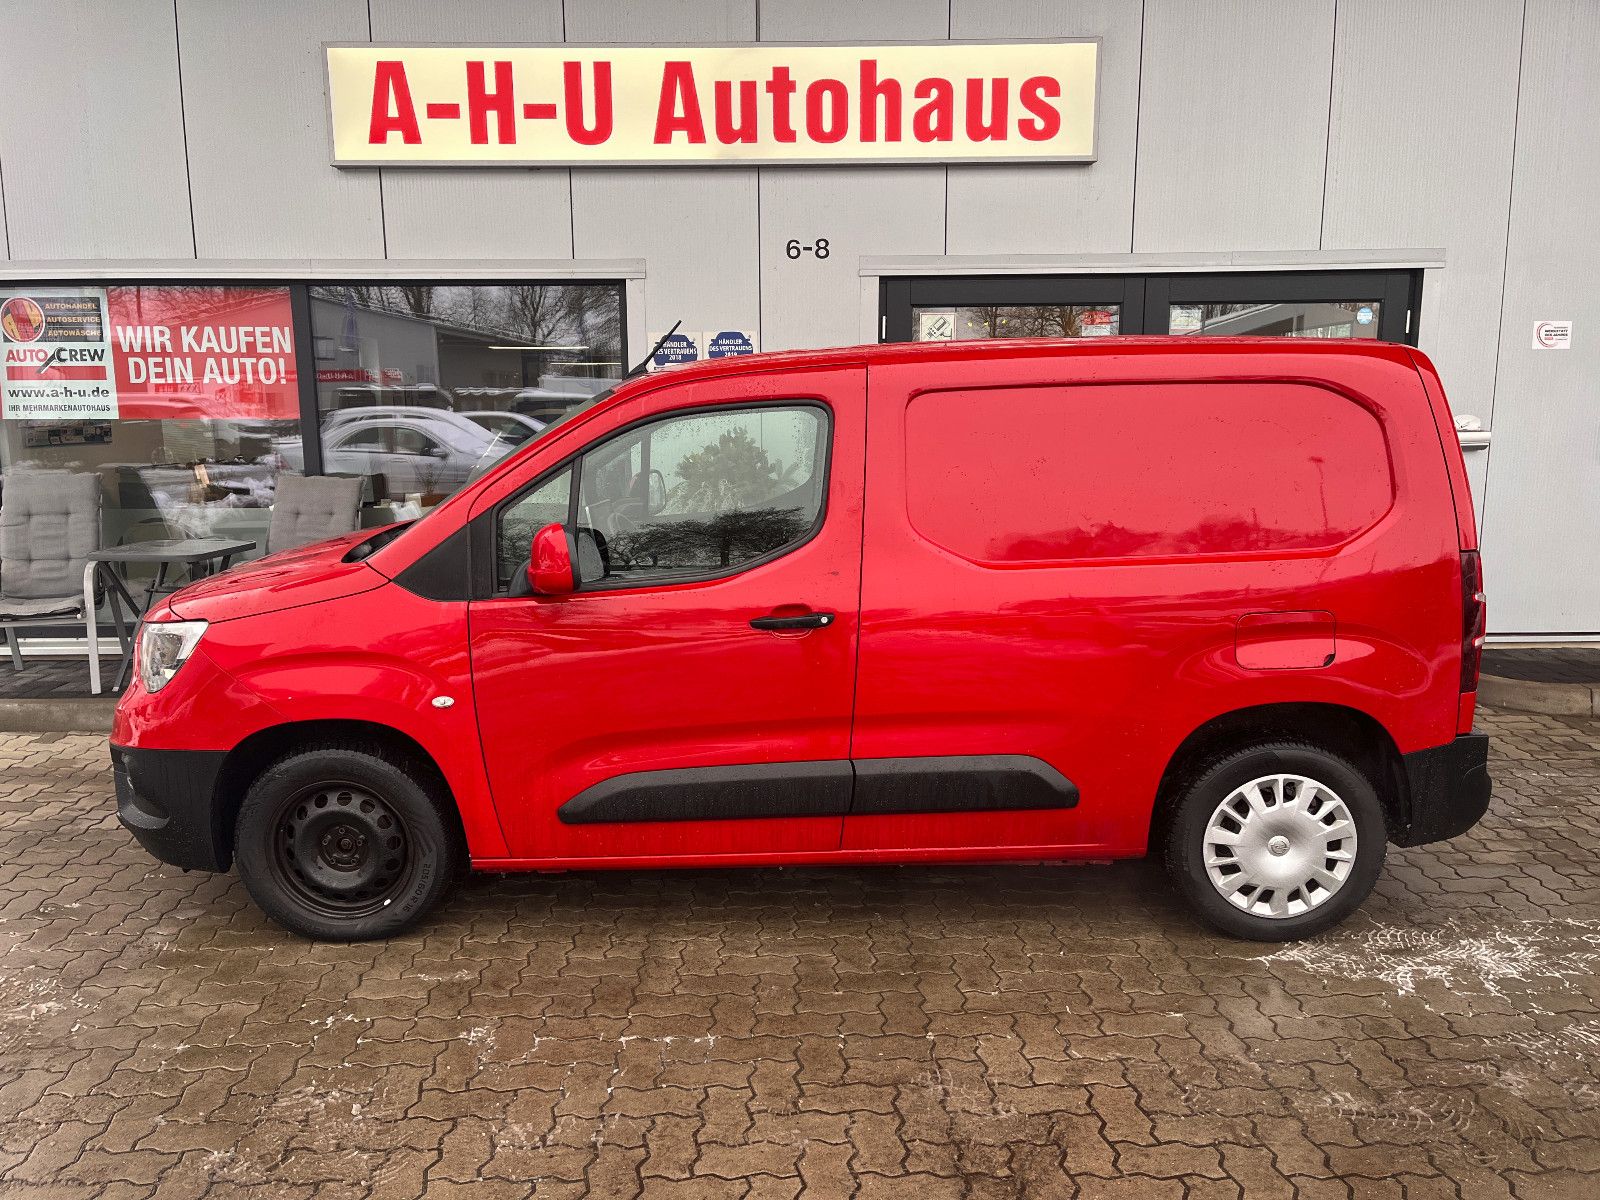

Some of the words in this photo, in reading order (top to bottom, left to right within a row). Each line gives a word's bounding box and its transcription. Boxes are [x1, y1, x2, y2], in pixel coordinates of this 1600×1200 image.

[367, 60, 613, 145] A-H-U
[653, 59, 1062, 145] Autohaus
[786, 238, 830, 259] 6-8
[116, 325, 174, 353] WIR
[181, 326, 292, 354] KAUFEN
[6, 349, 48, 363] AUTO
[55, 347, 105, 363] CREW
[127, 357, 194, 384] DEIN
[203, 357, 287, 385] AUTO!
[8, 387, 110, 397] www.a-h-u.de
[22, 404, 111, 412] MEHRMARKENAUTOHAUS
